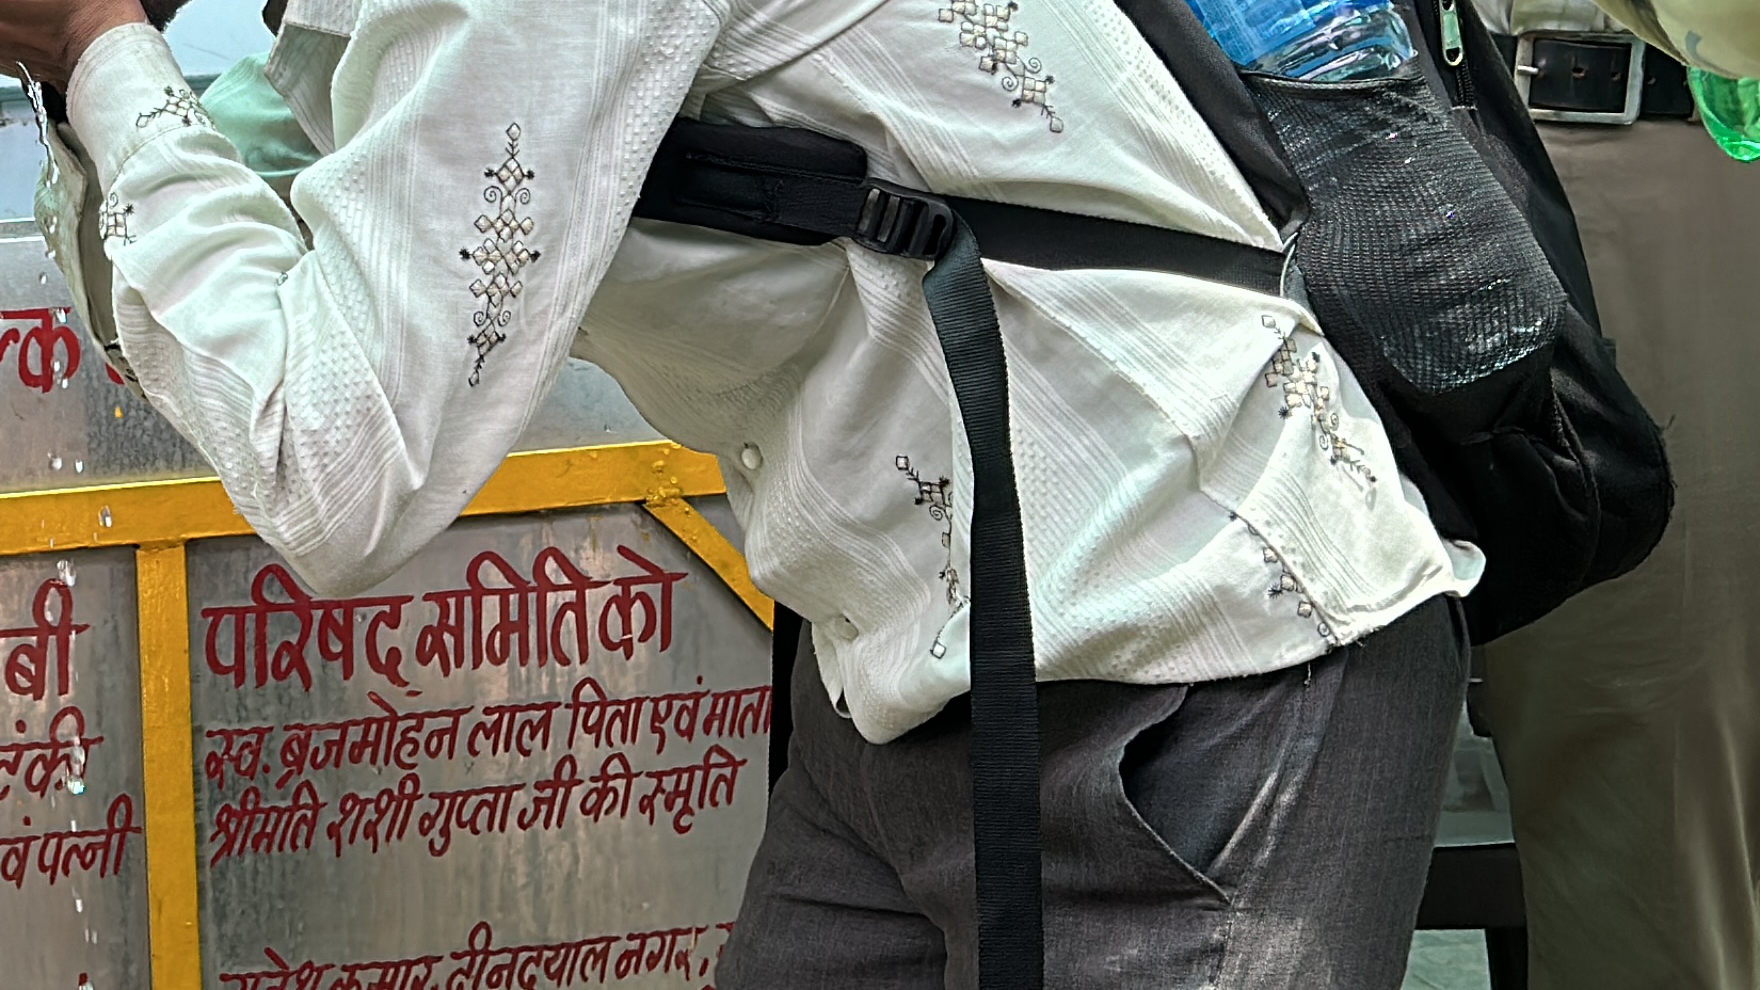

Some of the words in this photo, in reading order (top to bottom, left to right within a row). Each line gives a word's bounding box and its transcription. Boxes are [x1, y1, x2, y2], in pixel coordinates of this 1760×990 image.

[415, 545, 613, 678] समिति
[598, 545, 687, 670] को
[467, 701, 562, 758] लाल
[565, 677, 650, 748] पिता
[648, 676, 709, 754] एवं
[703, 685, 772, 738] माता
[37, 794, 142, 884] पत्नी
[210, 781, 328, 867] श्रीमति
[326, 772, 424, 858] शशी
[418, 785, 527, 857] गुप्ता
[517, 754, 586, 831] जी
[580, 752, 642, 822] की
[638, 744, 747, 835] स्मृति
